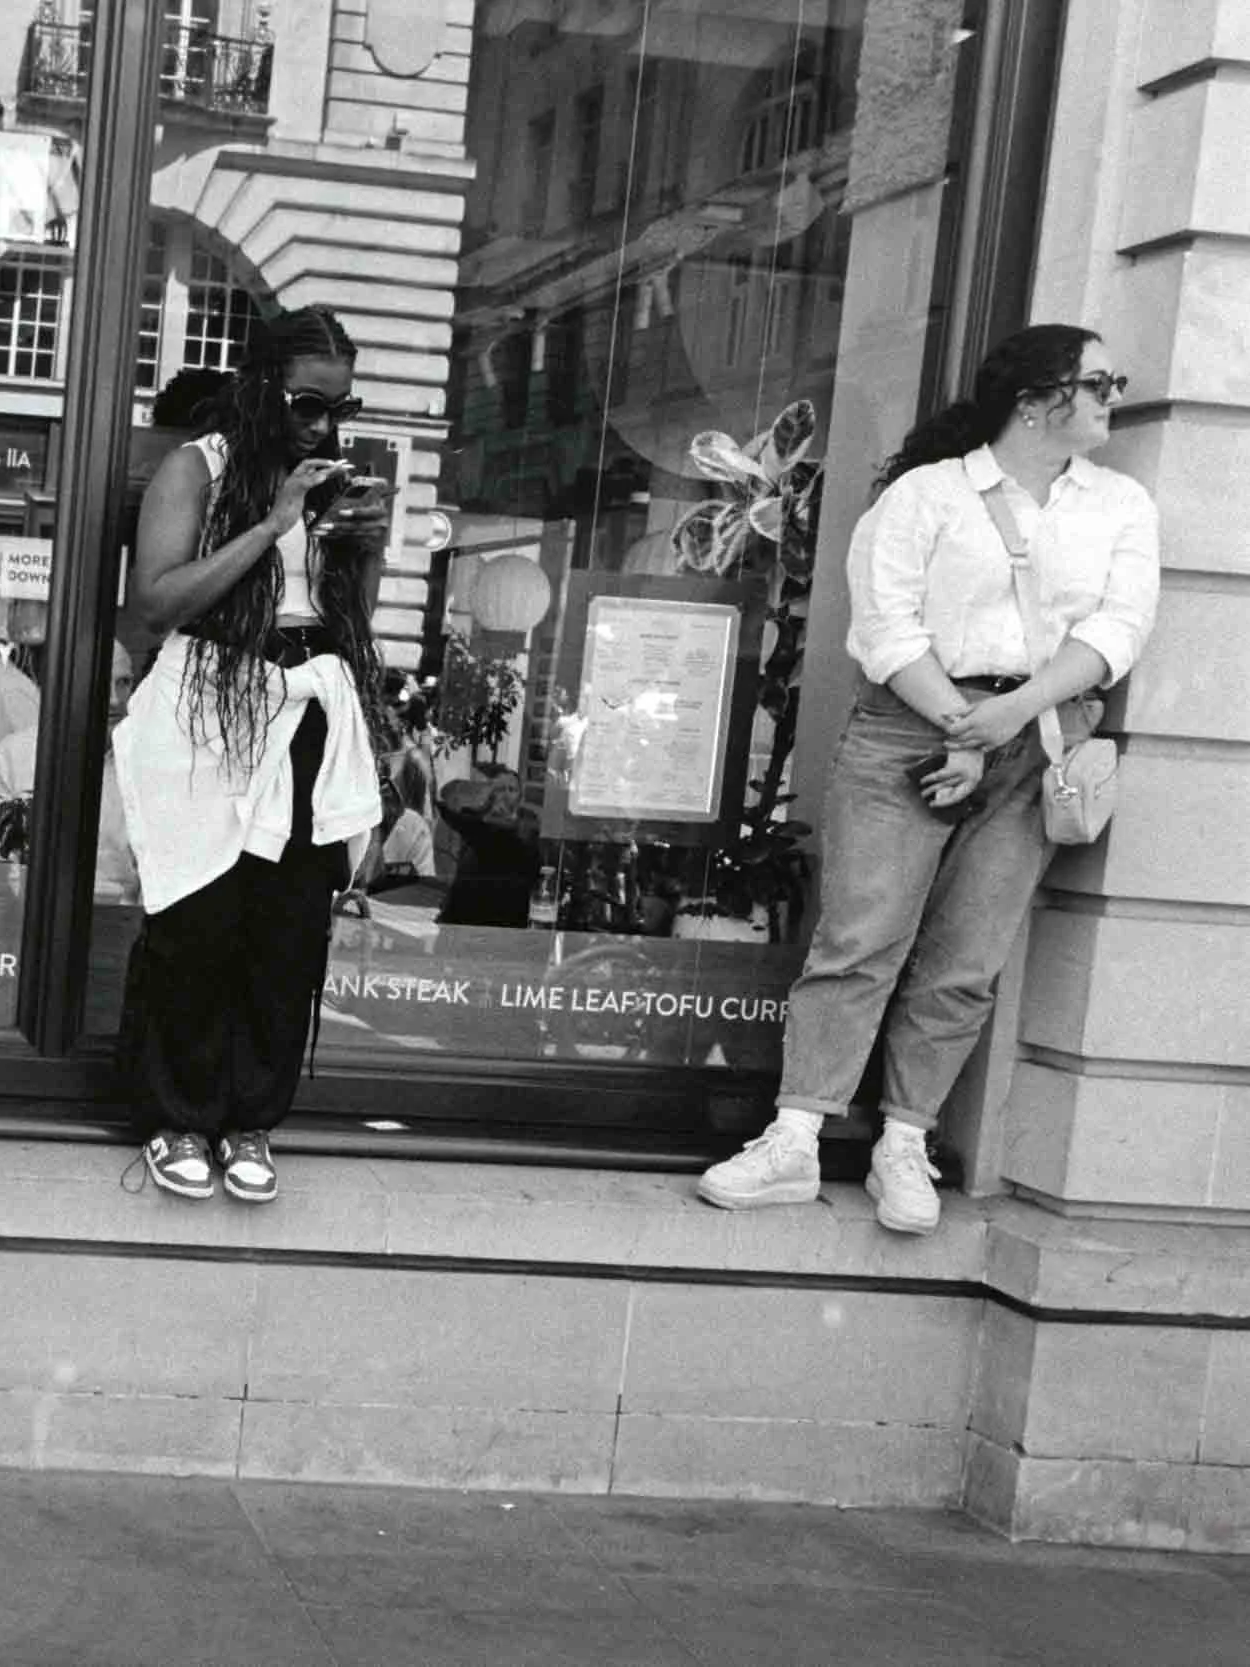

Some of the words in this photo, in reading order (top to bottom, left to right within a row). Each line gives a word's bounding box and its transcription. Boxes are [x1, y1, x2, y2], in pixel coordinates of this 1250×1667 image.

[9, 553, 50, 567] MORE
[386, 976, 471, 1005] STEAK
[500, 983, 565, 1010] LIME
[571, 988, 638, 1014] LEAF
[642, 992, 714, 1018] TOFU
